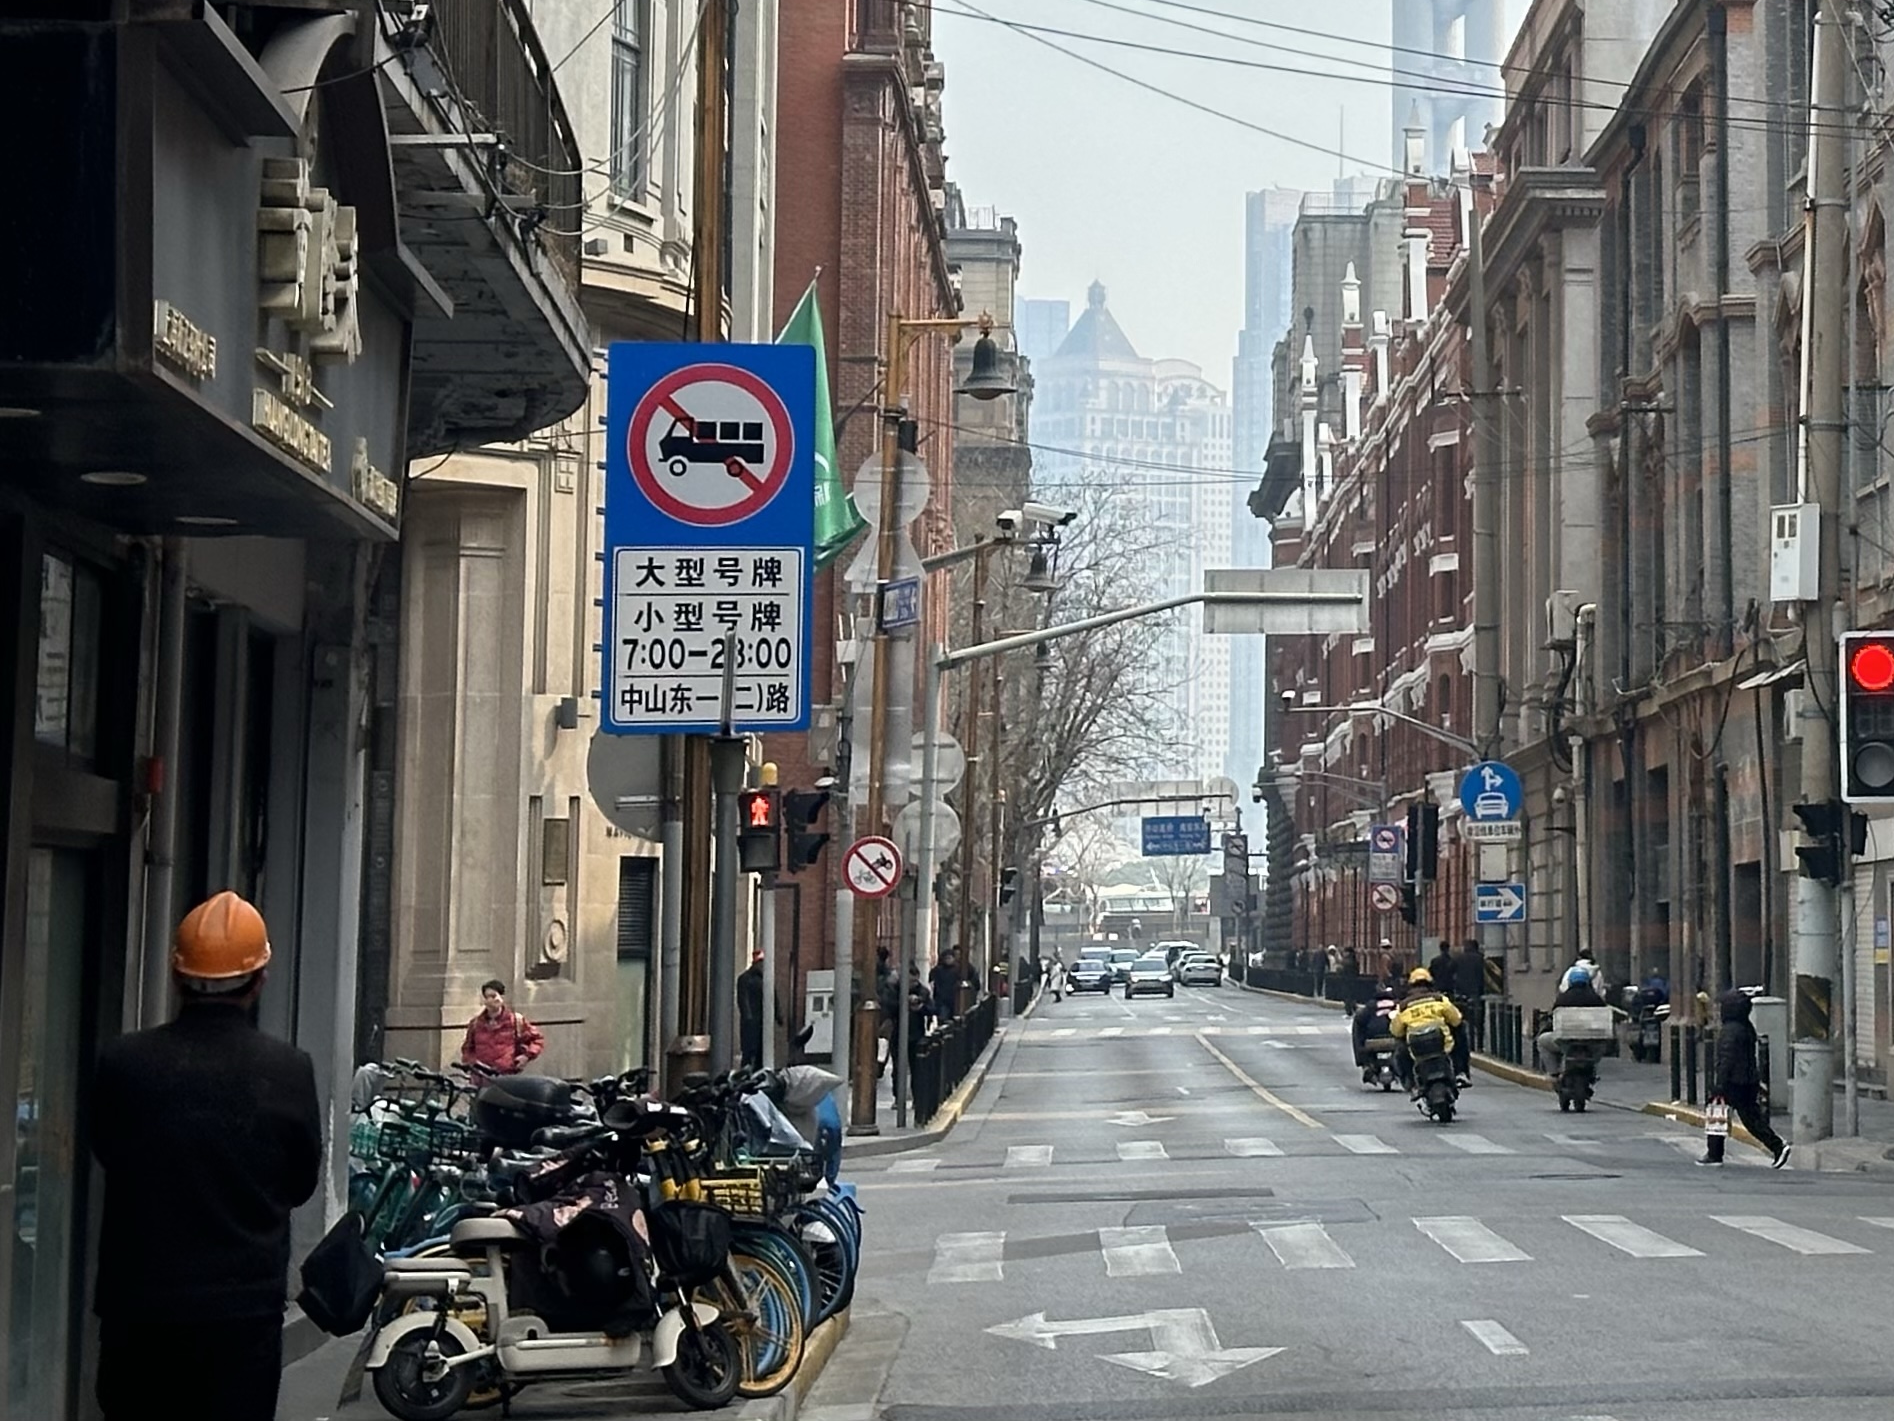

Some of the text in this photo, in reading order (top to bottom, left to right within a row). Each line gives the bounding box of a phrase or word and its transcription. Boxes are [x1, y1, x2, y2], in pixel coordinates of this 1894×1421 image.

[636, 557, 782, 587] 大型号牌
[634, 601, 782, 632] 小型号牌
[621, 682, 789, 715] 中山东一二)路
